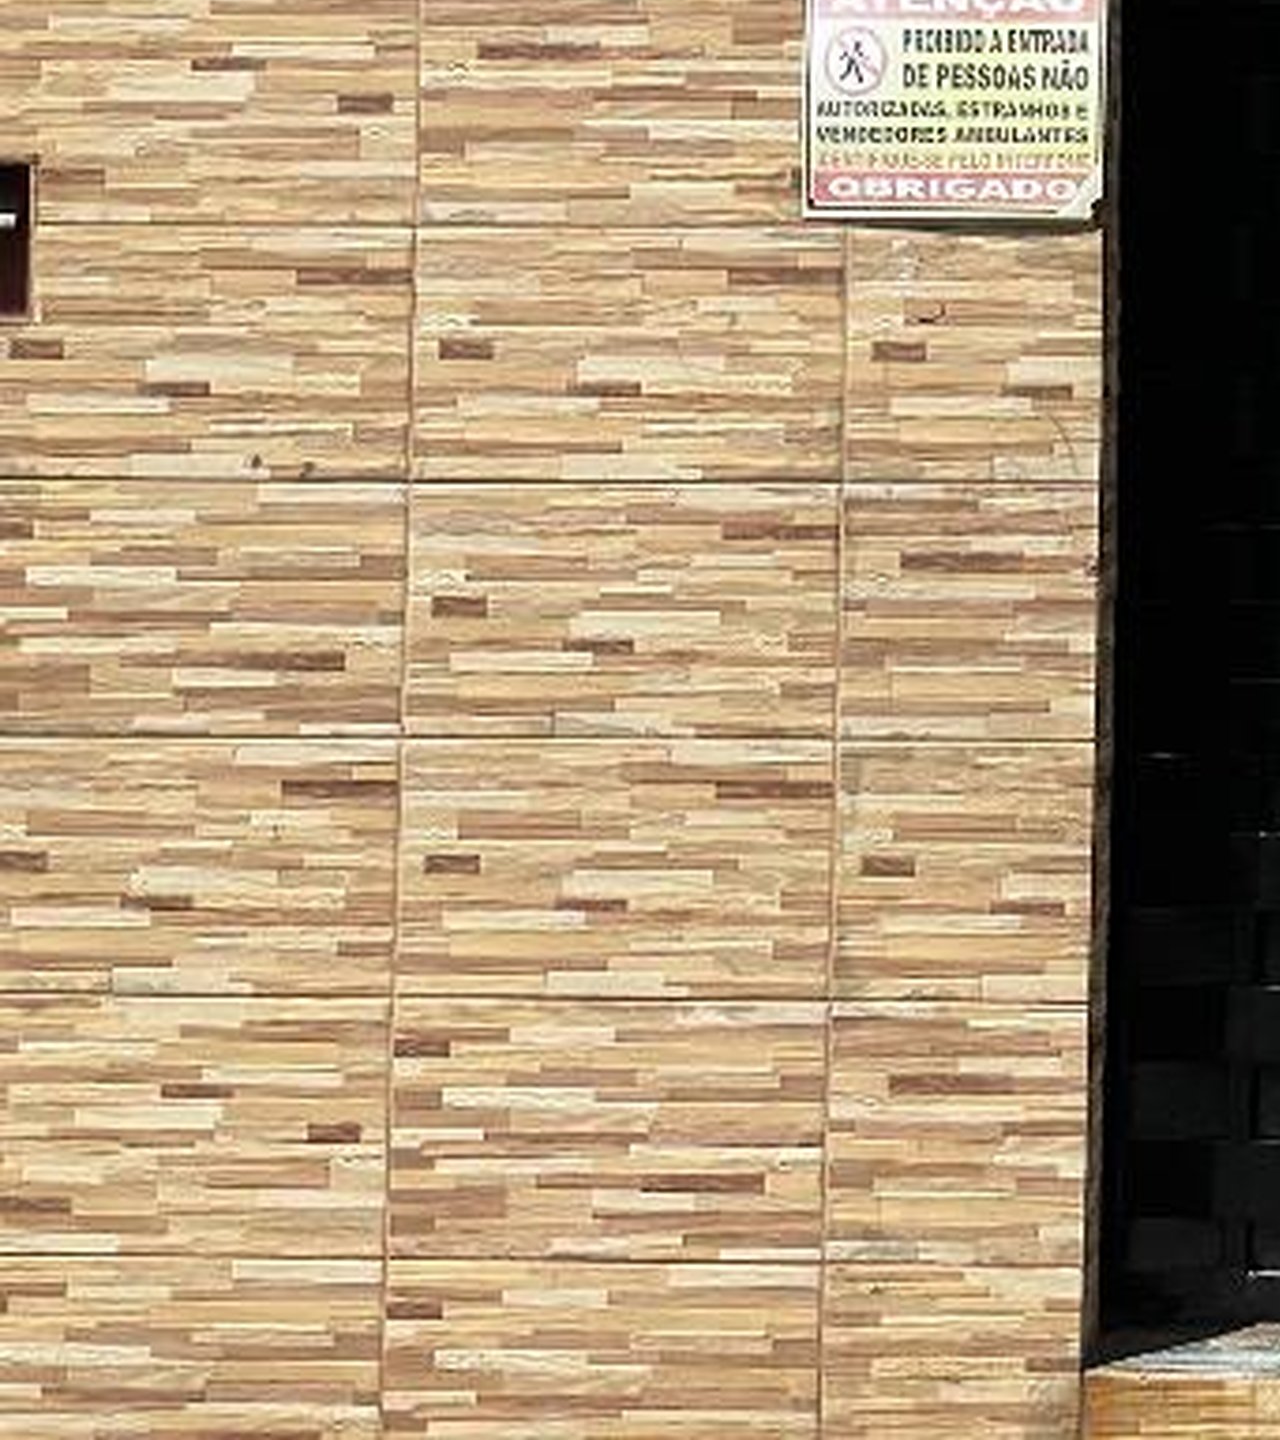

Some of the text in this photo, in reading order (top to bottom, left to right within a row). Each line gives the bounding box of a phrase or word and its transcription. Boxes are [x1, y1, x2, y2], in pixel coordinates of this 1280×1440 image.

[989, 29, 1002, 53] A
[1008, 29, 1089, 53] ENTRADA
[903, 59, 1089, 90] DE PESSOAS NÃO
[828, 177, 1076, 200] OBRIGADO
